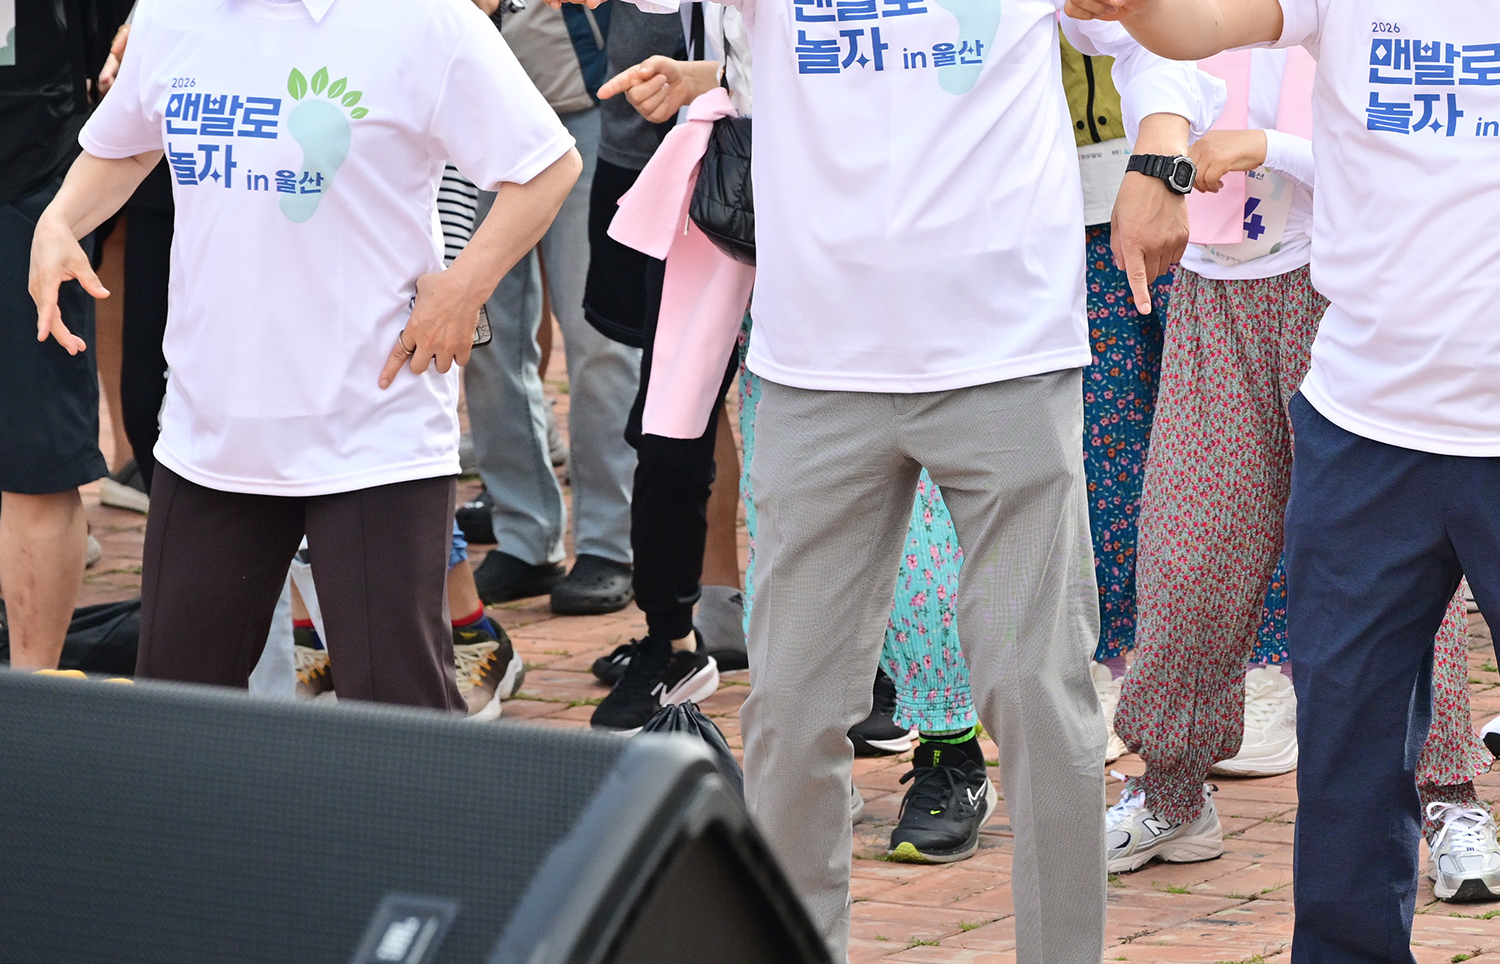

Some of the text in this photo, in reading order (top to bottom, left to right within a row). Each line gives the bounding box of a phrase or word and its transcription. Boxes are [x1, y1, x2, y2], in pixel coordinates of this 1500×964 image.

[795, 26, 984, 74] 놀자 in 울산
[1372, 22, 1401, 33] 2026
[172, 77, 196, 88] 2026
[165, 92, 282, 139] 맨발로
[1365, 91, 1464, 137] 놀자
[1475, 116, 1499, 136] in
[168, 142, 324, 194] 놀자 in 울산
